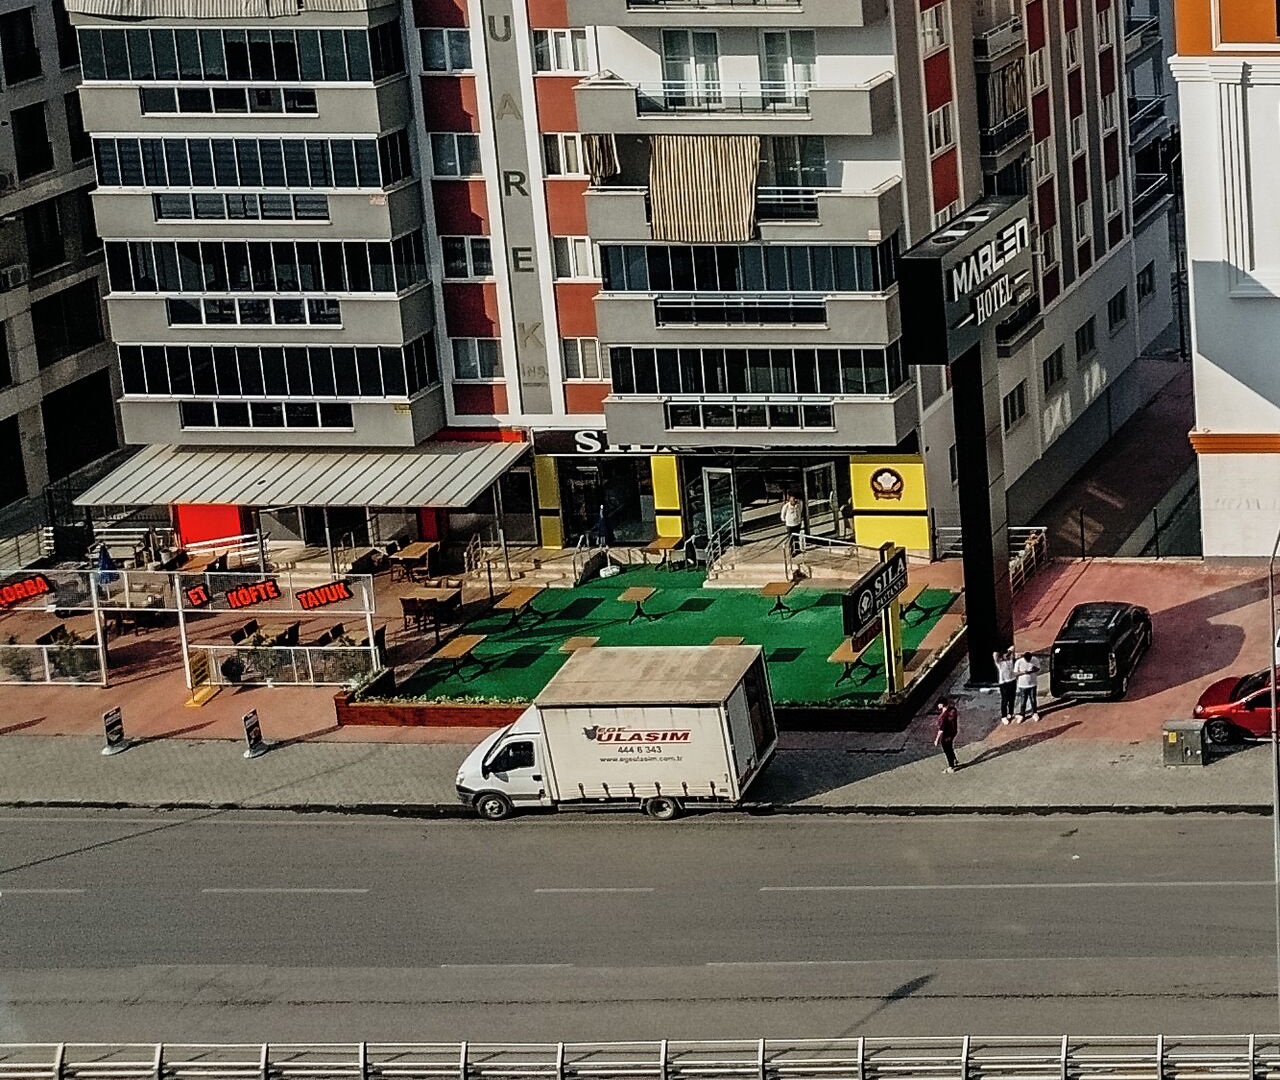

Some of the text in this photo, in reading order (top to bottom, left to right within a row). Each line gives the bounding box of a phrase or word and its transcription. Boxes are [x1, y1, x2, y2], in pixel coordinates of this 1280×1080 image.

[952, 217, 1029, 302] MARLEN
[976, 274, 1013, 326] HOTEL
[188, 586, 208, 606] ET
[227, 581, 278, 609] KÖFTE
[297, 582, 350, 609] TAVUK
